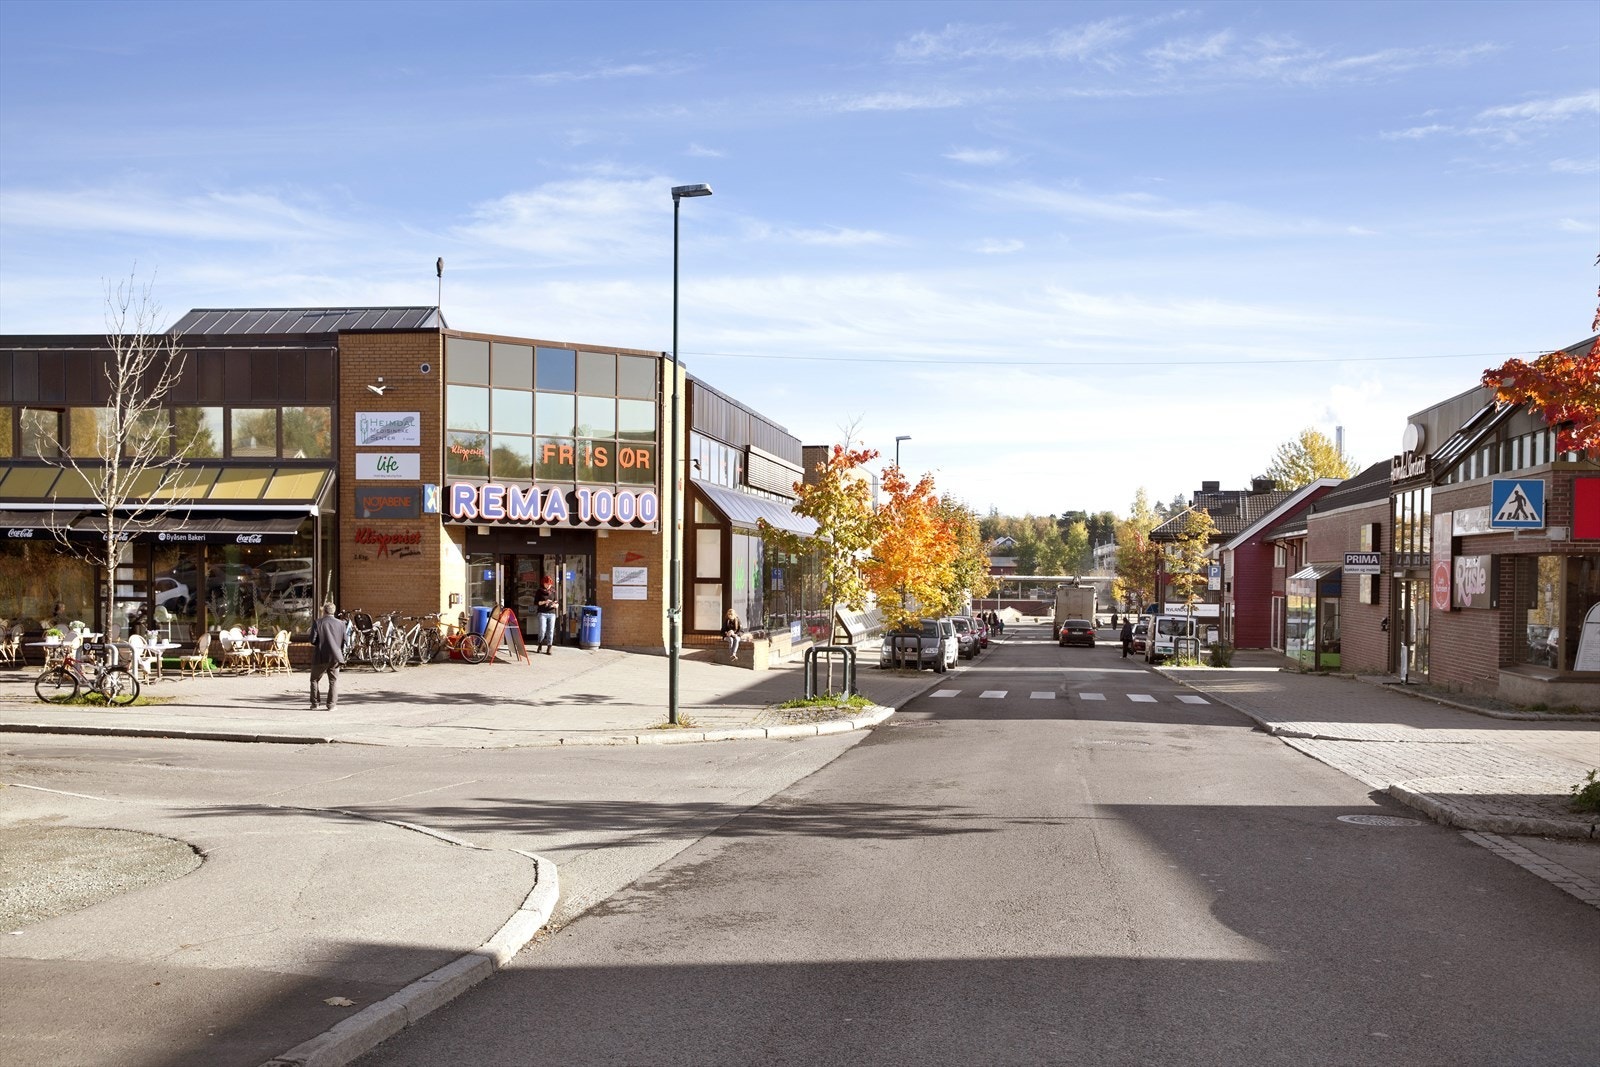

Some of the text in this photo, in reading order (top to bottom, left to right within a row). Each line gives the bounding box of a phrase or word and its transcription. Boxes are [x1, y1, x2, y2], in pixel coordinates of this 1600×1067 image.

[376, 455, 399, 473] life
[451, 482, 657, 524] REMA 1000
[166, 533, 206, 542] Byåsen Bakeri
[1346, 555, 1378, 564] PRIMA
